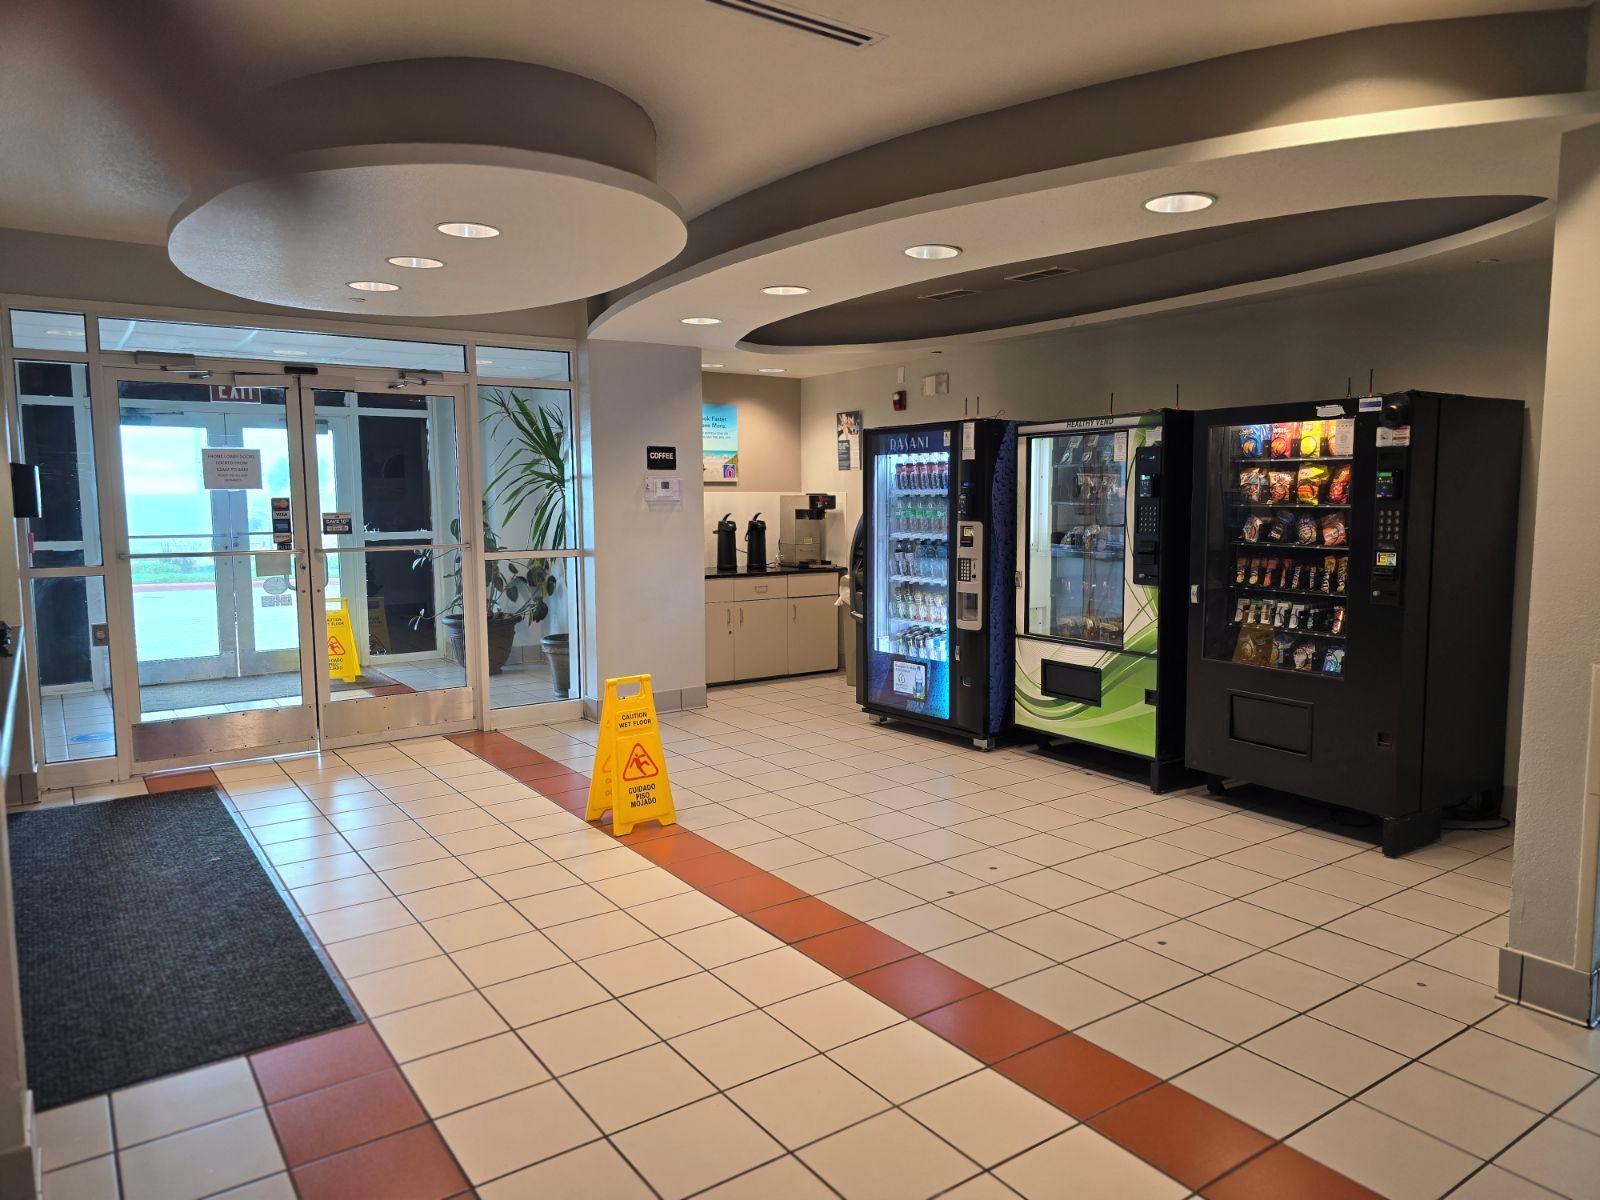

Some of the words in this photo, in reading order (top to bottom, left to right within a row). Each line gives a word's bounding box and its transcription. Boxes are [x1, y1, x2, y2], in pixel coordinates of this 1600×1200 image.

[218, 385, 254, 400] EXIT
[1066, 418, 1095, 428] HEALTHY
[1096, 418, 1115, 427] VEND
[890, 433, 929, 452] DASANI
[649, 452, 674, 460] COFFEE
[621, 712, 648, 721] CAUTION
[633, 718, 652, 726] FLOOR
[628, 783, 656, 794] CUIDADO
[635, 791, 650, 800] PISO
[630, 797, 657, 808] MOJADO
